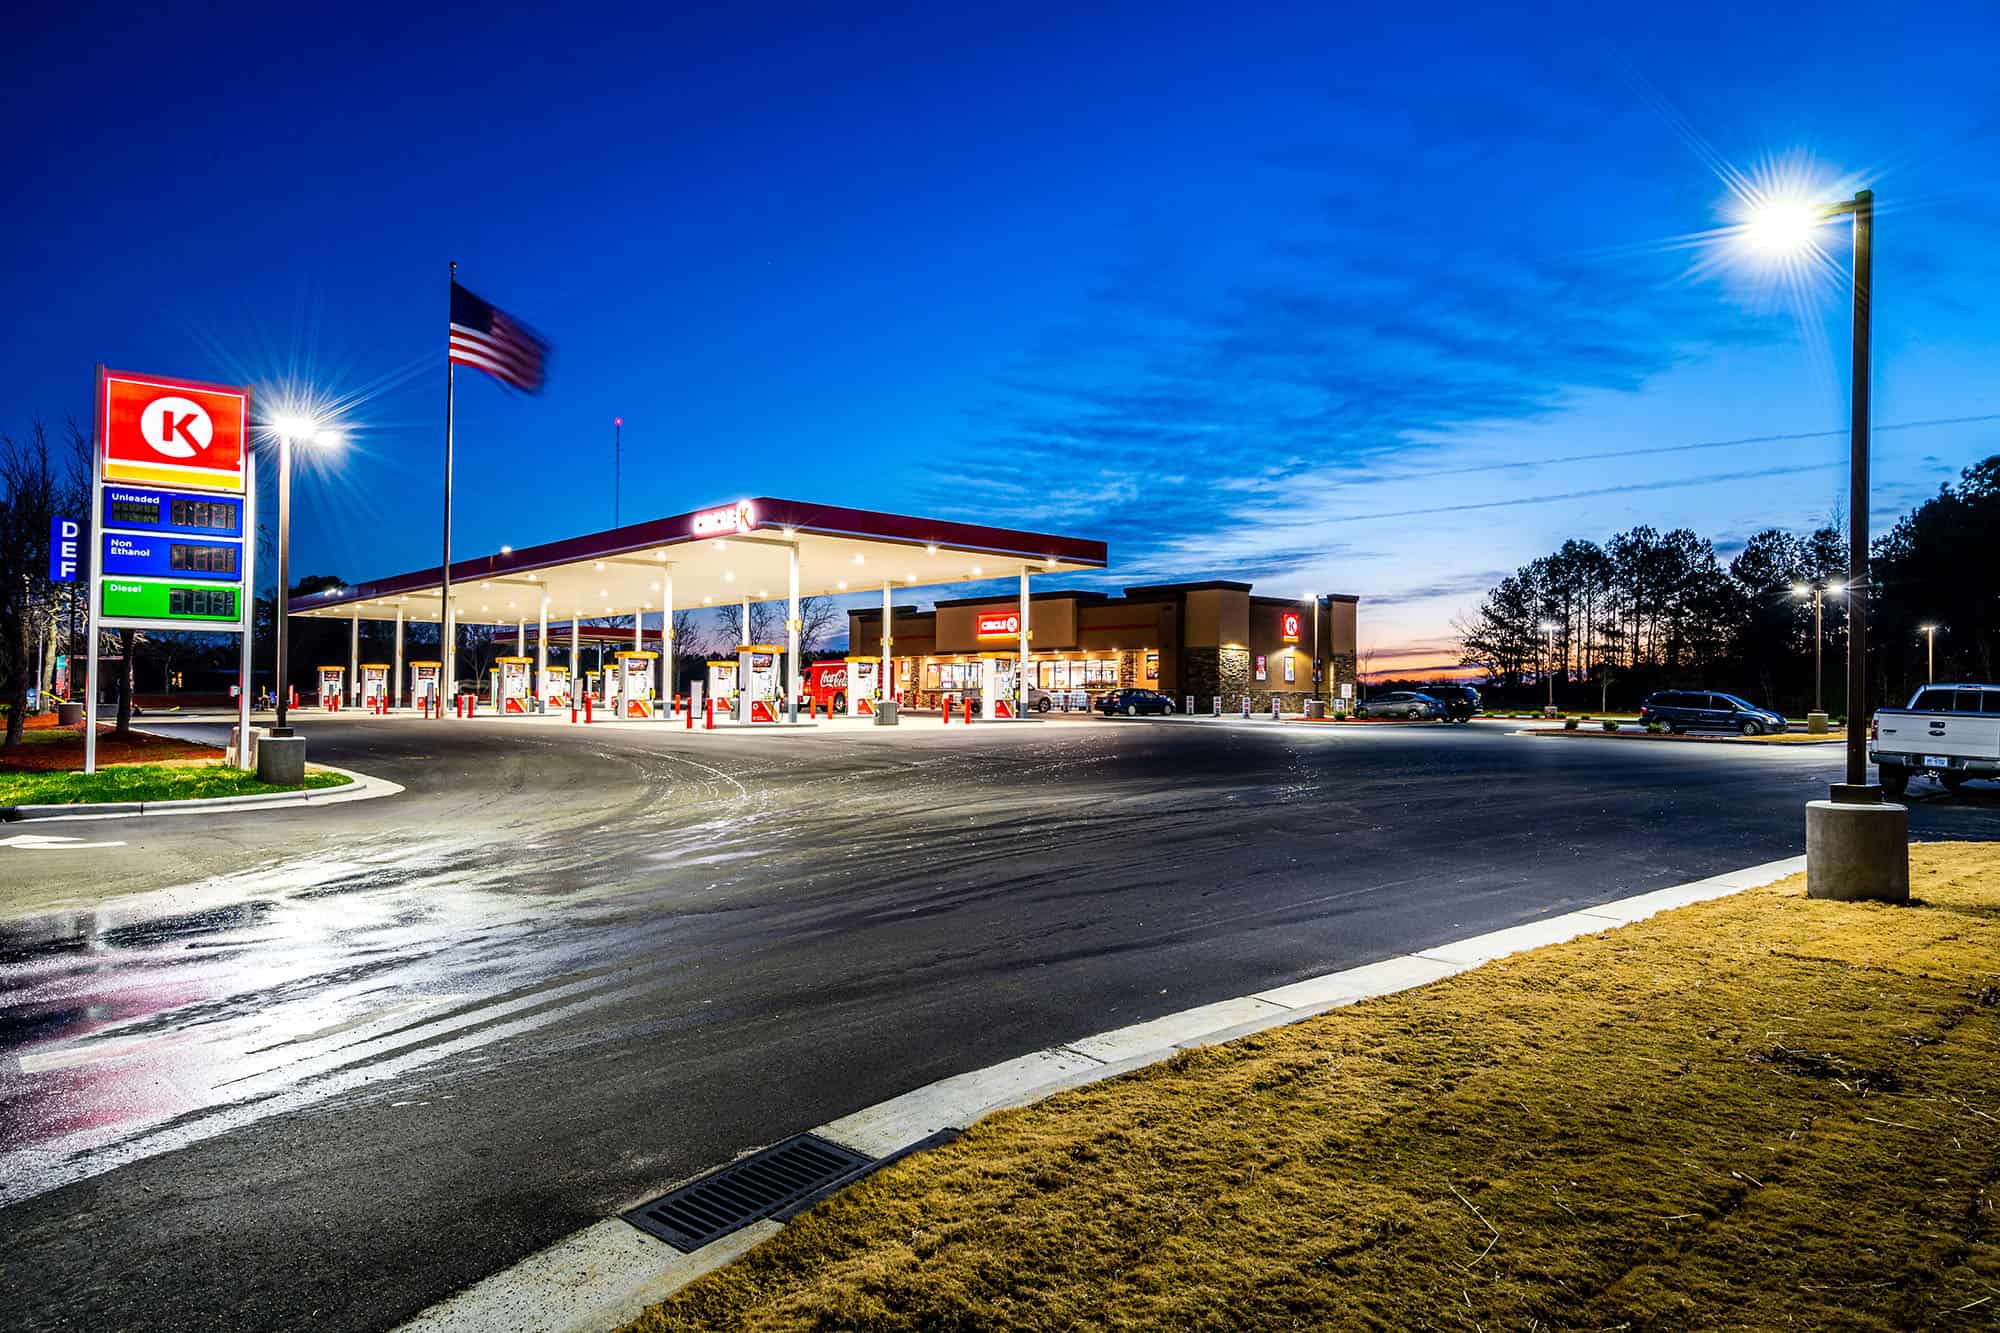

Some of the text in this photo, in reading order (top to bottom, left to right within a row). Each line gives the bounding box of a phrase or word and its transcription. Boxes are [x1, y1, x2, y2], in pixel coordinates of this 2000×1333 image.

[160, 409, 205, 457] K
[111, 493, 160, 504] Unleaded
[111, 538, 132, 548] Non
[61, 521, 80, 577] DEF
[111, 547, 150, 557] Ethanol
[110, 583, 142, 593] Diesel
